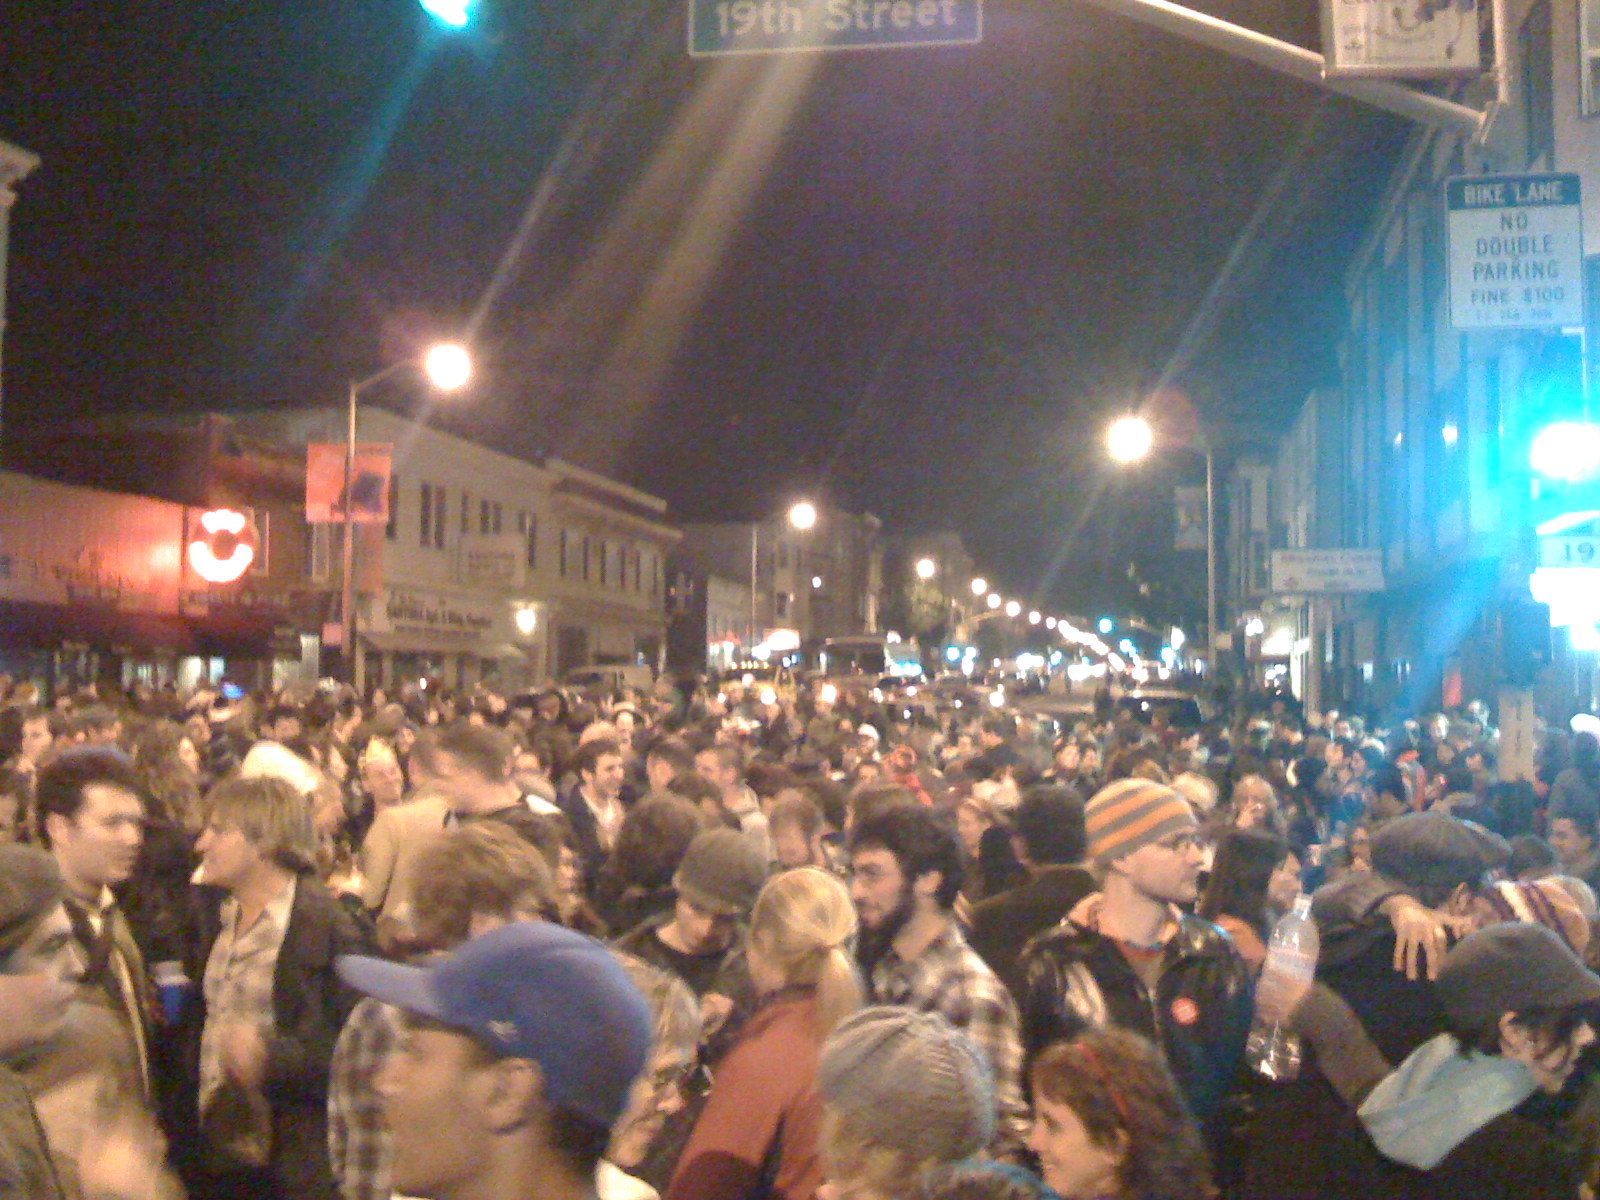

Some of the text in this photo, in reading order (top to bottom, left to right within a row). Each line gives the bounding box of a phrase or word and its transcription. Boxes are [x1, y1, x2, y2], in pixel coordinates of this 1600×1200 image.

[715, 0, 957, 36] 19th Street
[1464, 181, 1563, 205] BIKE LANE
[1500, 211, 1529, 231] NO
[1475, 234, 1553, 257] DOUBLE
[1472, 259, 1560, 282] PARKING
[1470, 286, 1566, 305] FINE $100
